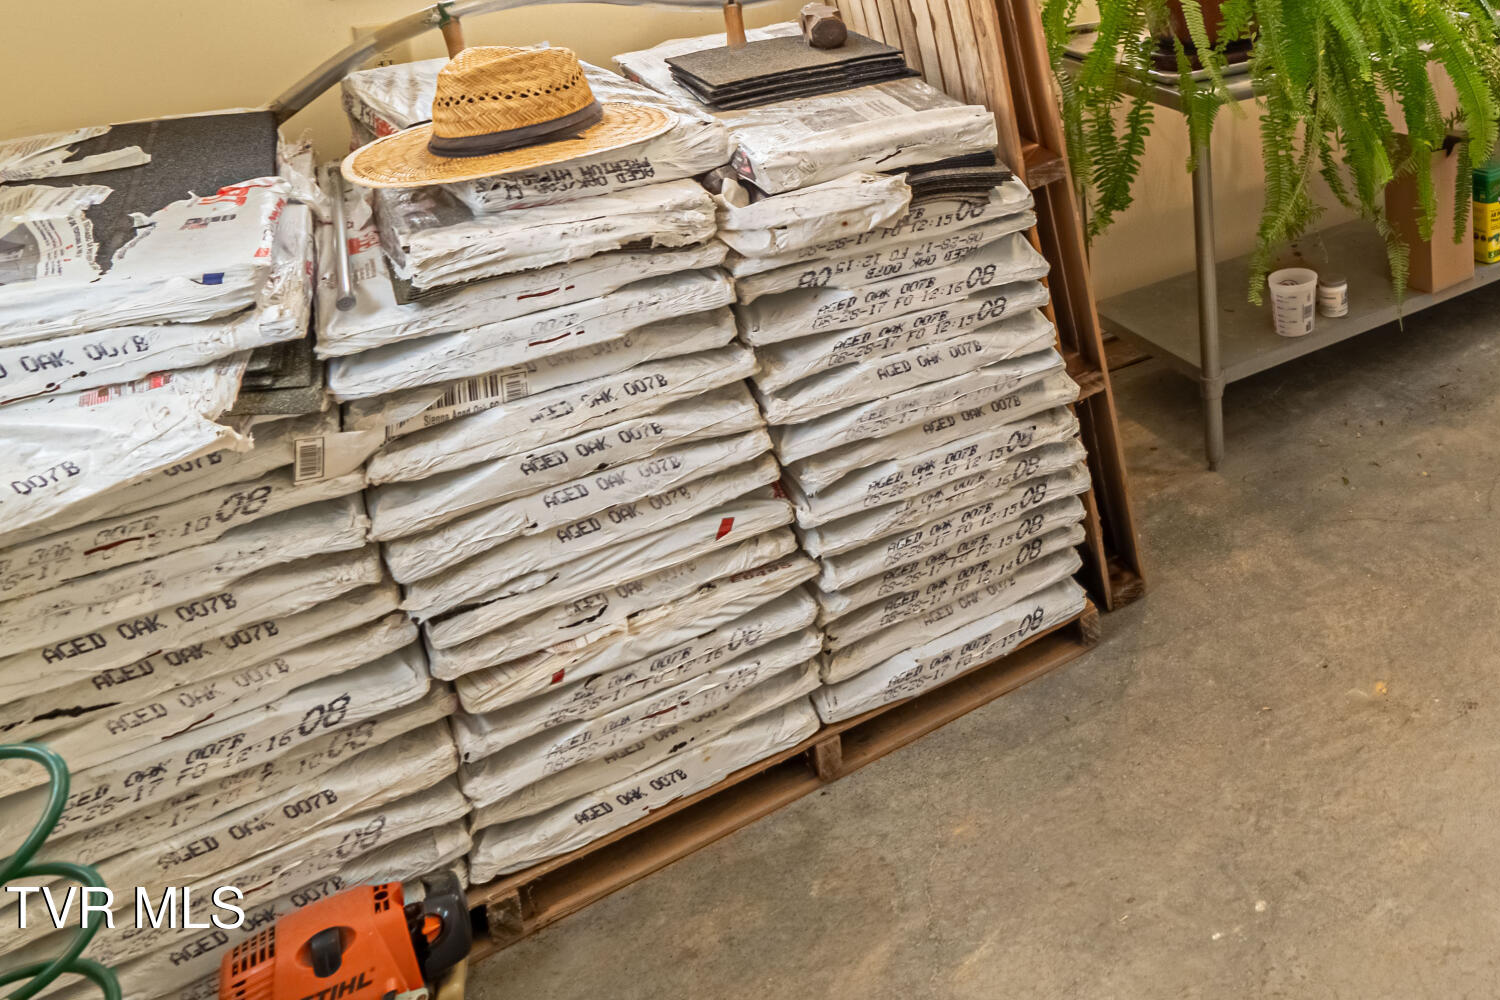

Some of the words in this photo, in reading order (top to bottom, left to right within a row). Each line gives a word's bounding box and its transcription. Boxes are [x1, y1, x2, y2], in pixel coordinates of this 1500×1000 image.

[911, 214, 952, 233] 12:15
[912, 254, 937, 270] OAK
[20, 350, 73, 374] OAK
[878, 360, 913, 381] AGED
[923, 417, 956, 435] AGED
[961, 407, 986, 422] OAK
[519, 450, 569, 477] AGED
[575, 436, 614, 459] OAK
[215, 485, 272, 524] 08
[543, 483, 590, 509] AGED
[595, 470, 630, 492] OAK
[1019, 483, 1048, 509] 08
[556, 519, 602, 545] AGED
[608, 503, 645, 525] OAK
[1015, 513, 1045, 540] 08
[1015, 538, 1043, 565] 08
[615, 580, 648, 600] OAK
[42, 631, 107, 664] AGED
[116, 613, 167, 641] OAK
[1018, 606, 1045, 638] 08
[91, 660, 155, 691] AGED
[164, 642, 212, 668] OAK
[104, 701, 168, 735] AGED
[178, 681, 225, 709] OAK
[298, 692, 352, 737] 08
[573, 800, 614, 826] AGED
[616, 786, 649, 807] OAK
[156, 835, 220, 869] AGED
[228, 818, 276, 841] OAK
[335, 814, 388, 860] 08
[168, 929, 230, 967] AGED
[298, 971, 374, 1000] TIHL
